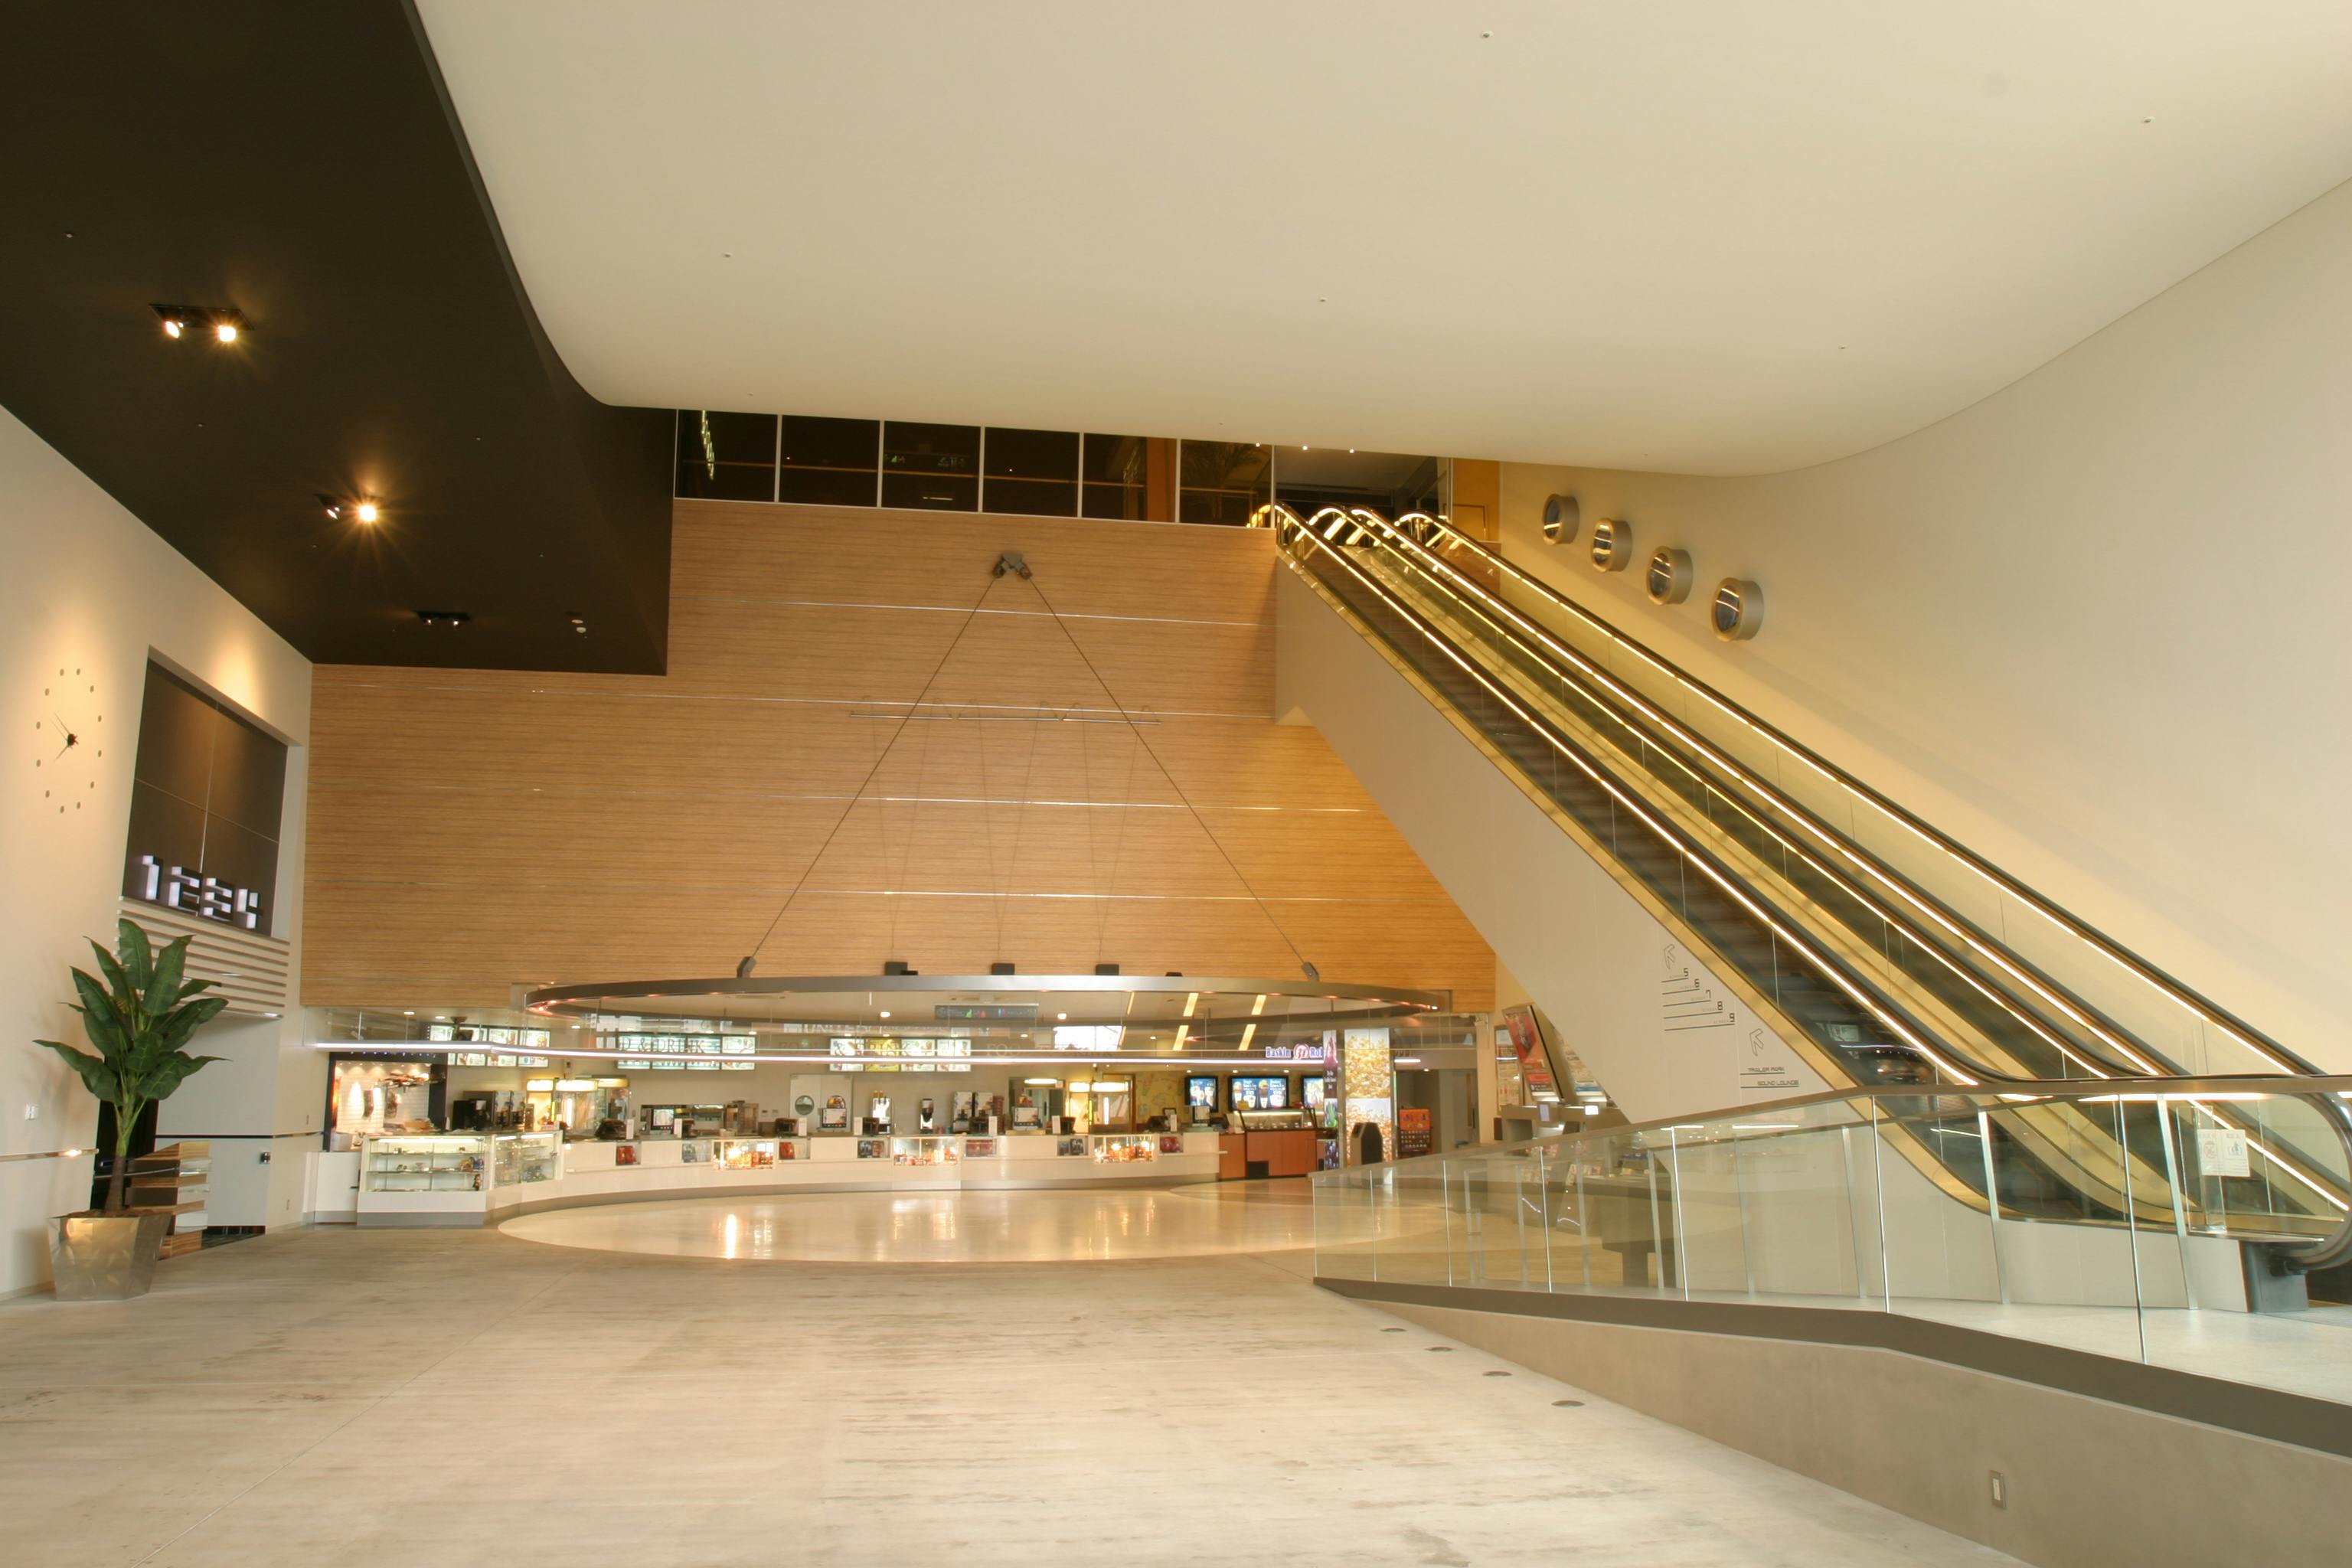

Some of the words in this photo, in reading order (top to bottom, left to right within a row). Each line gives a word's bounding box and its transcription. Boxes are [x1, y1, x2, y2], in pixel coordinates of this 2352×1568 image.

[1684, 968, 1689, 977] 5
[1694, 978, 1700, 988] 6
[1706, 989, 1711, 998] 7
[1717, 1001, 1723, 1011] 8
[1730, 1013, 1735, 1023] 9
[1266, 1047, 1291, 1057] Baskin
